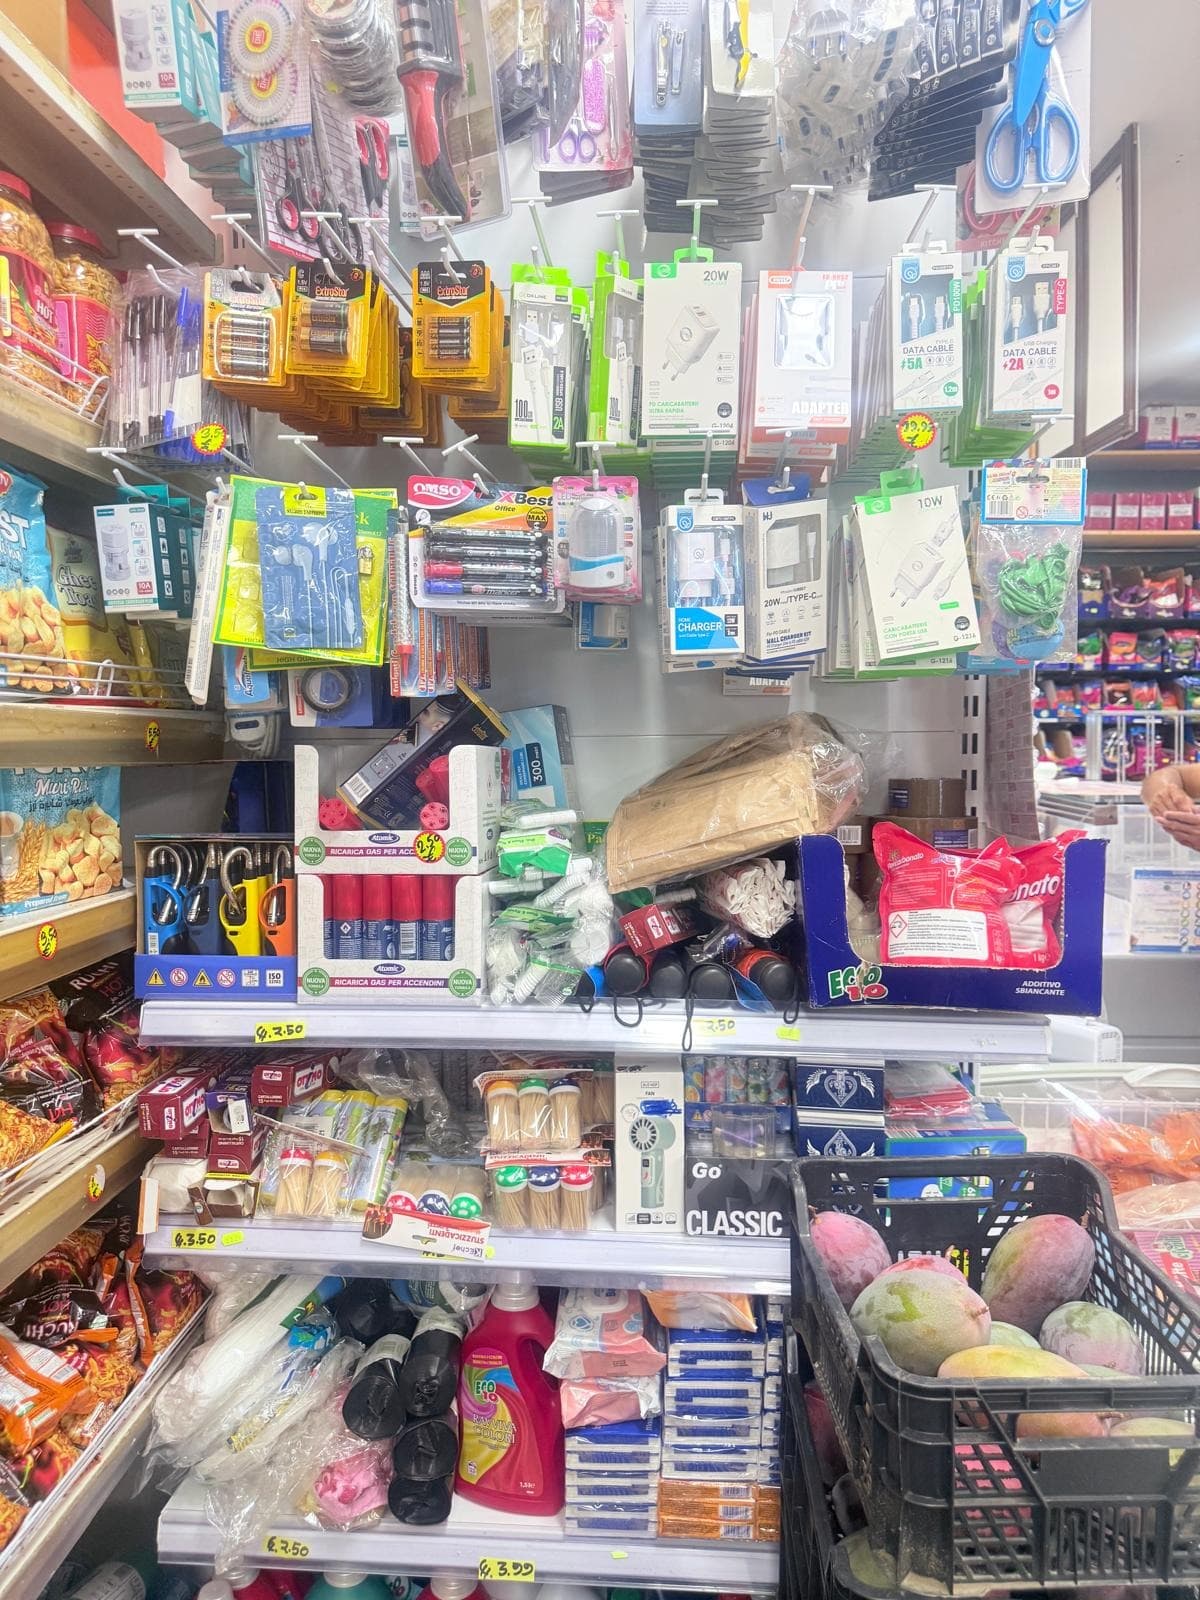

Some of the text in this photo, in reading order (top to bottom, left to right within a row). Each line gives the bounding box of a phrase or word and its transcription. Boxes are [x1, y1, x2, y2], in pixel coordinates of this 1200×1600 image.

[160, 72, 175, 82] 10A
[703, 270, 729, 282] 20W
[1055, 281, 1066, 312] TYPE-C
[36, 302, 55, 318] HOT
[902, 343, 954, 355] DATA CABLE
[1003, 346, 1057, 358] DATA CABLE
[907, 356, 923, 371] 5A
[1008, 357, 1025, 371] 2A
[515, 398, 528, 418] 100
[554, 397, 563, 412] USB
[791, 401, 849, 416] ADAPTER
[553, 416, 564, 430] 2A
[413, 482, 462, 498] OMSO
[917, 495, 943, 509] 10W
[494, 505, 516, 513] Office
[526, 515, 547, 523] MAX
[137, 582, 152, 590] 10A
[764, 598, 781, 608] 20W
[678, 621, 722, 632] CHARGER
[531, 760, 543, 782] 300
[370, 833, 395, 842] Atomic
[330, 848, 363, 856] RICARICA
[365, 848, 381, 856] GAS
[383, 848, 398, 856] PER
[448, 846, 468, 854] NUOVA
[25, 895, 52, 909] Prepared
[376, 965, 400, 974] Atomic
[268, 972, 282, 980] ISO
[334, 979, 445, 988] RICARICA GAS PER ACCENDINI
[453, 979, 472, 987] NUOVA
[1022, 980, 1061, 989] ADDITIVO
[1015, 987, 1065, 997] SBIANCANTE
[692, 1162, 721, 1179] Go
[686, 1210, 783, 1237] CLASSIC
[429, 1228, 485, 1244] STUZZICADENTI
[475, 1380, 496, 1395] ECO
